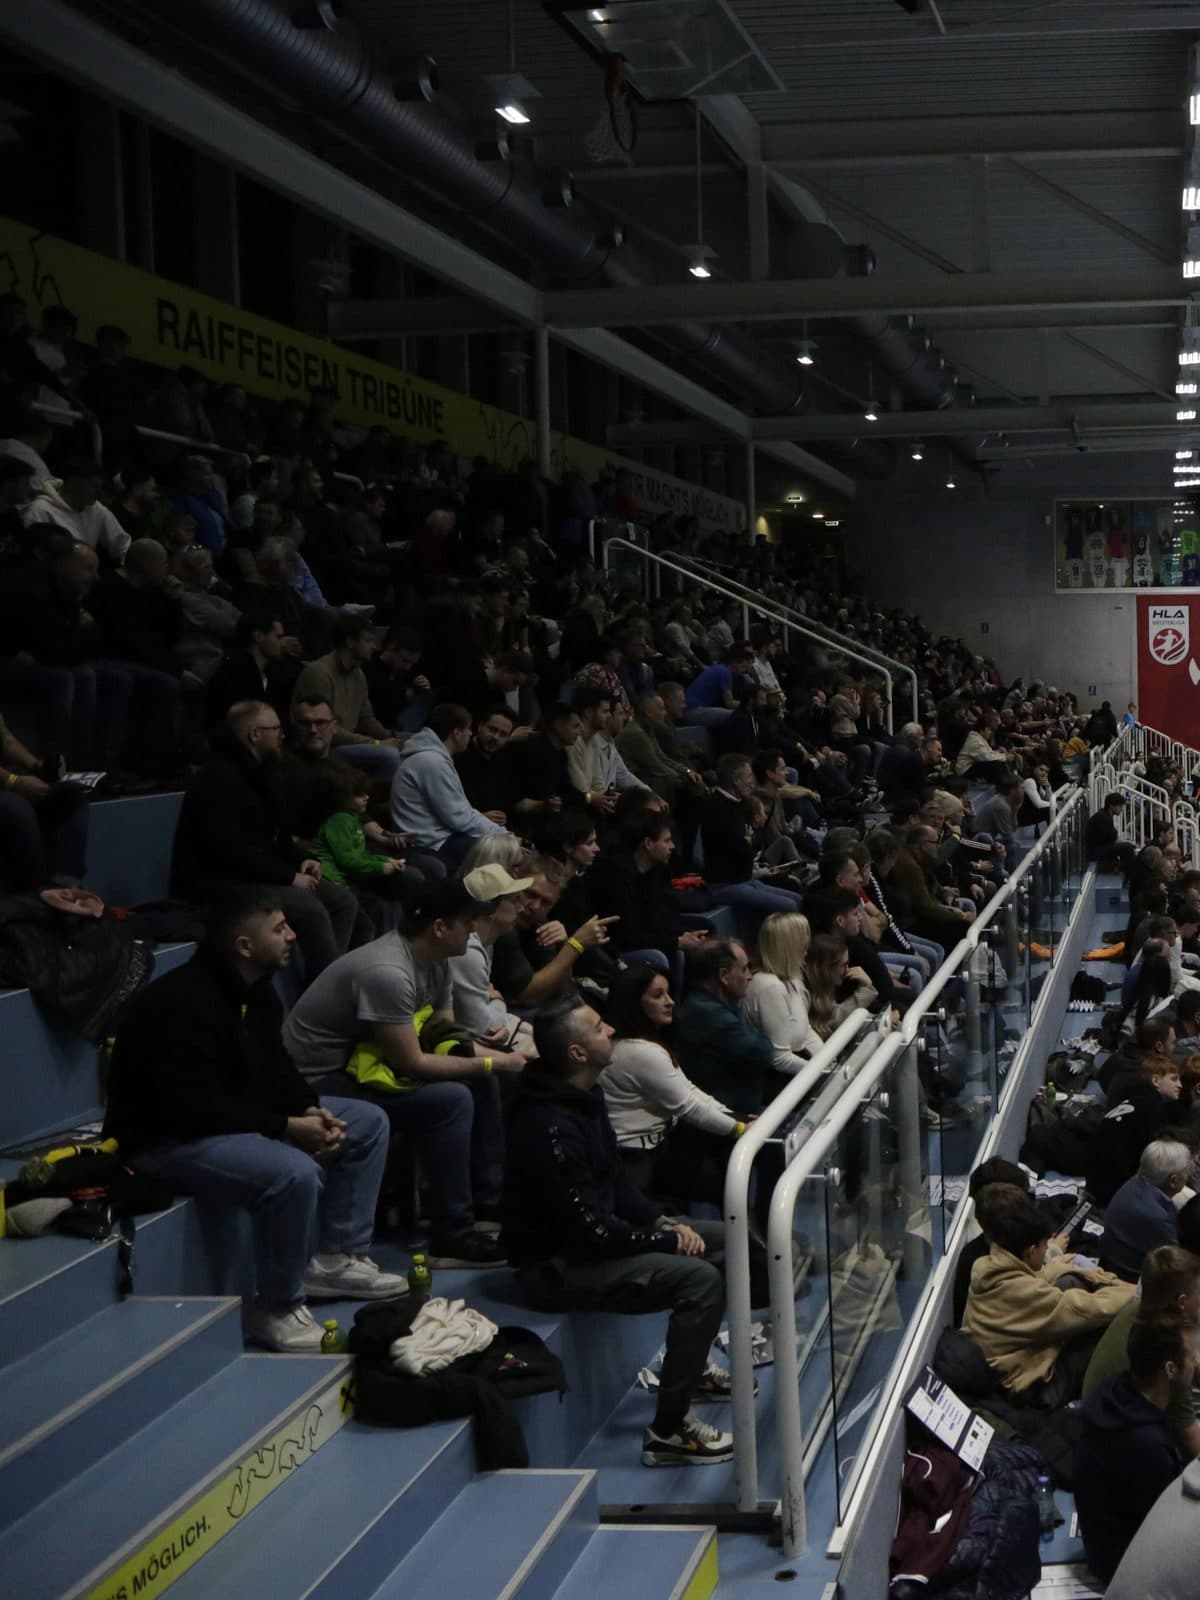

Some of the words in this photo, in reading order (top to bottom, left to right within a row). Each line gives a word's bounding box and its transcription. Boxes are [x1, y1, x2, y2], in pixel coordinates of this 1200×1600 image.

[156, 298, 339, 399] RAIFFEISEN
[346, 366, 445, 435] TRIBÜNE
[1152, 609, 1185, 618] HLA
[131, 1515, 211, 1596] MÖGLICH.
